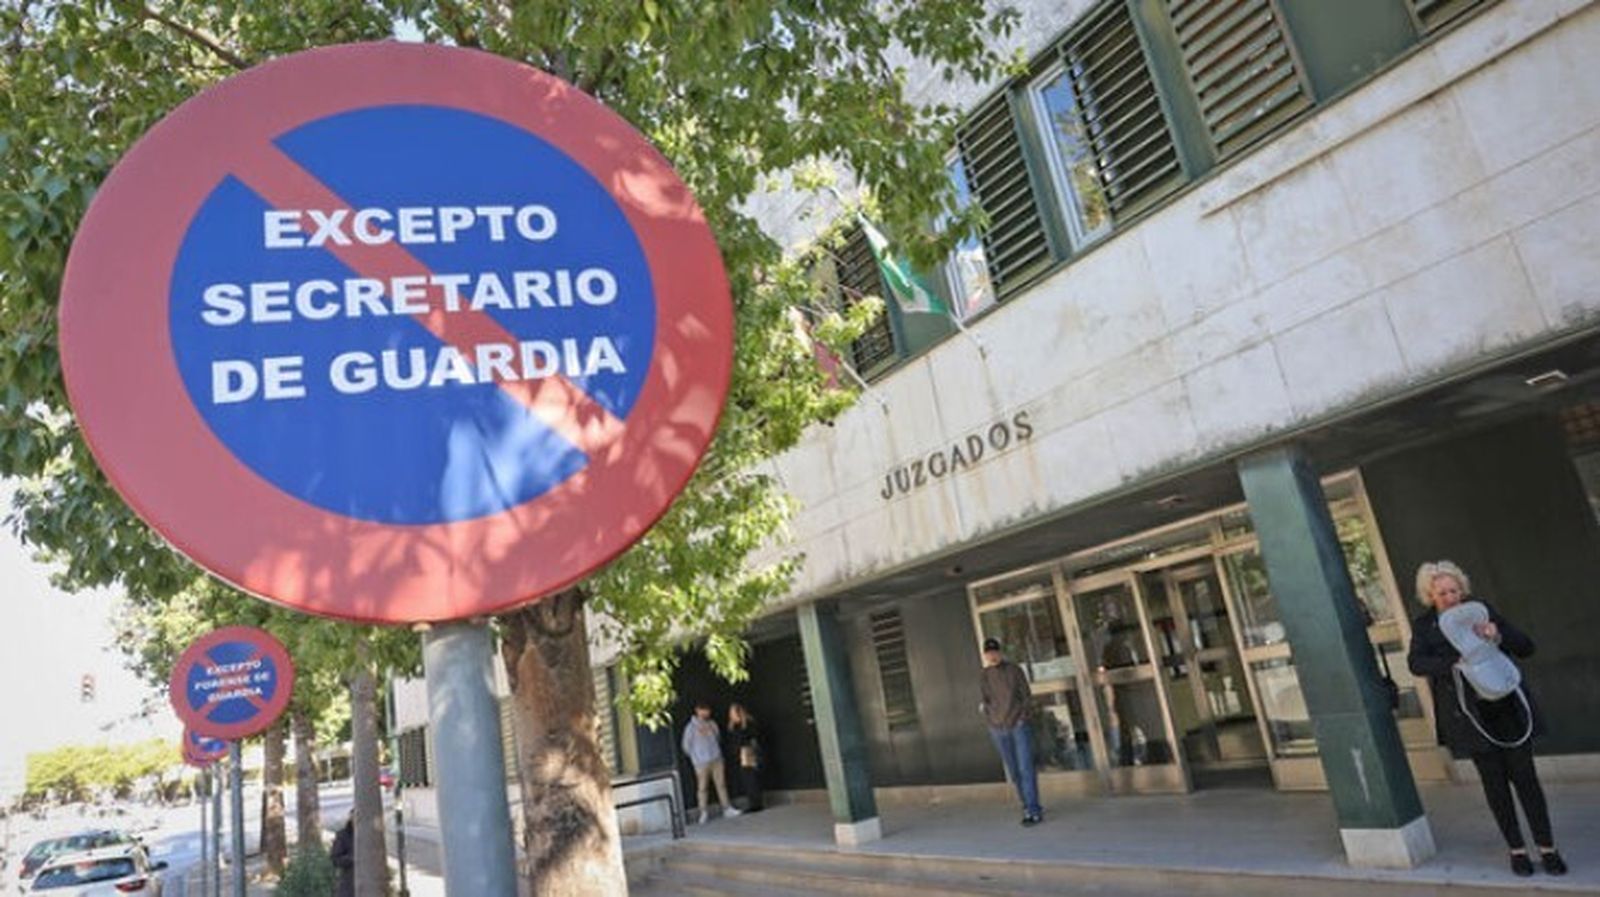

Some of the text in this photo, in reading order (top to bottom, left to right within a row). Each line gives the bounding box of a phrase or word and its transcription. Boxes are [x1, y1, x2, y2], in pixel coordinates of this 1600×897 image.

[264, 205, 557, 249] EXCEPTO
[201, 268, 618, 326] SECRETARIO
[212, 336, 626, 404] DE GUARDIA
[881, 410, 1034, 500] JUZGADOS
[206, 660, 262, 676] EXCEPTO
[207, 687, 263, 703] GUARDIA
